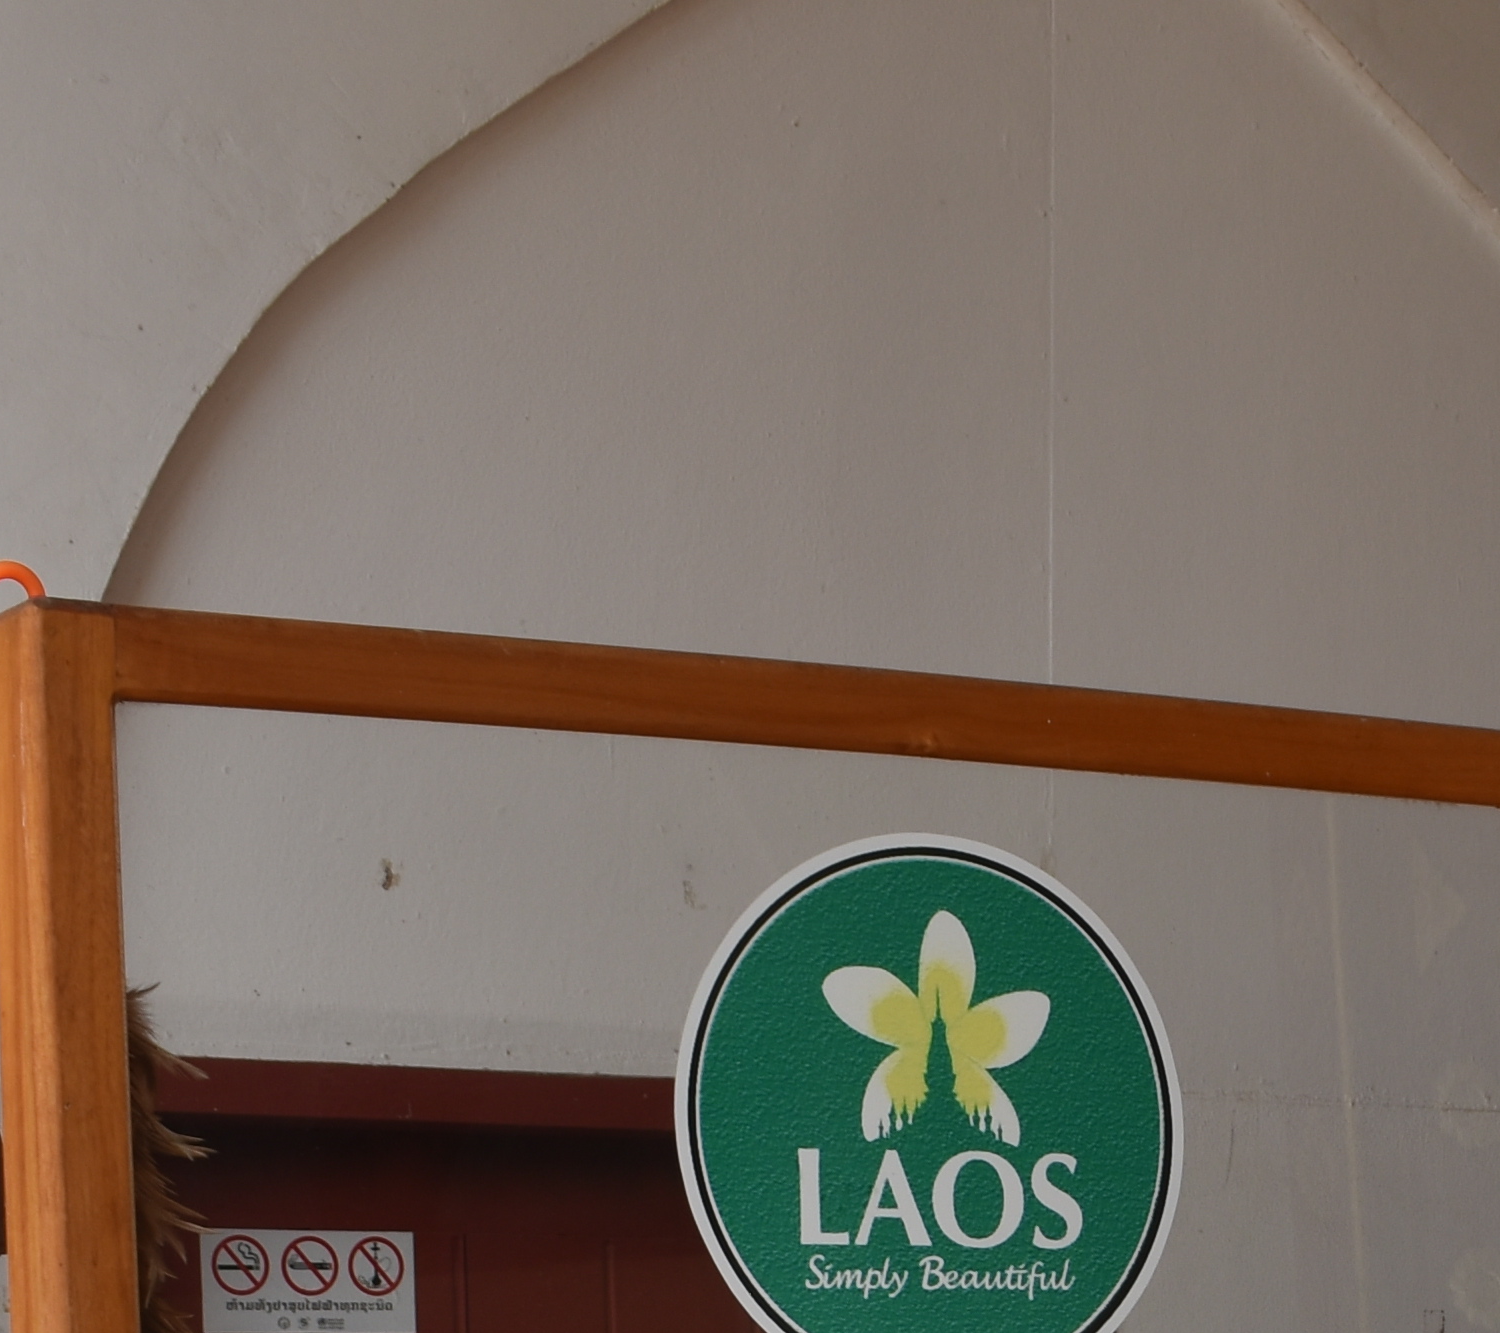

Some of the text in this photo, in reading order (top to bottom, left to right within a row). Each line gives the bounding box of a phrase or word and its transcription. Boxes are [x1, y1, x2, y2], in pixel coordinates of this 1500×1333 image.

[798, 1147, 1083, 1250] LAOS
[804, 1254, 1076, 1301] Simply Beautiful
